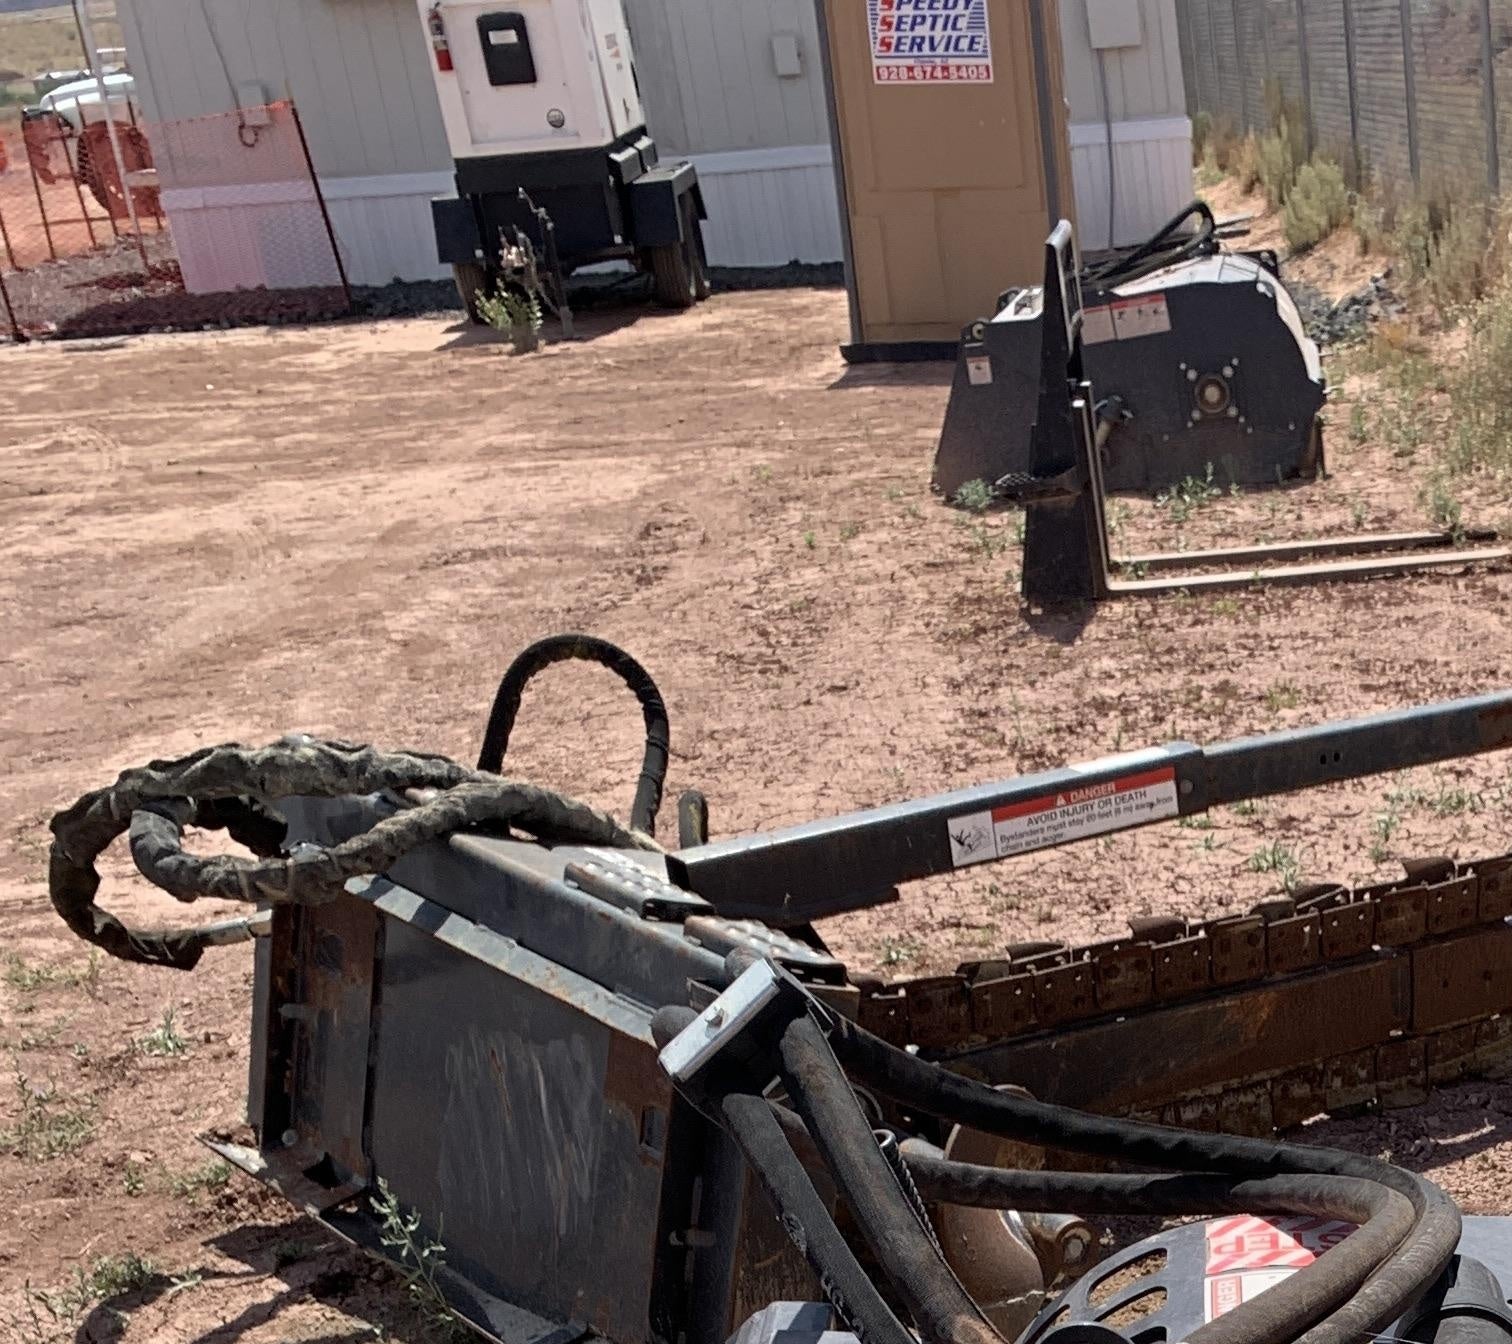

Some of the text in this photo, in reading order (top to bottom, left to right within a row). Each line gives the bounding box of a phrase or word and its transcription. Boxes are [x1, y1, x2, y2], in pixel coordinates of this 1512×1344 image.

[879, 0, 974, 11] SPEEDY
[878, 14, 966, 32] SEPTIC
[878, 35, 983, 53] SERVICE
[1071, 784, 1116, 800] DANGER
[1027, 790, 1147, 827] AVOID INJURY OR DEATH
[999, 827, 1045, 843] Bystanders
[1216, 1279, 1237, 1313] NGER
